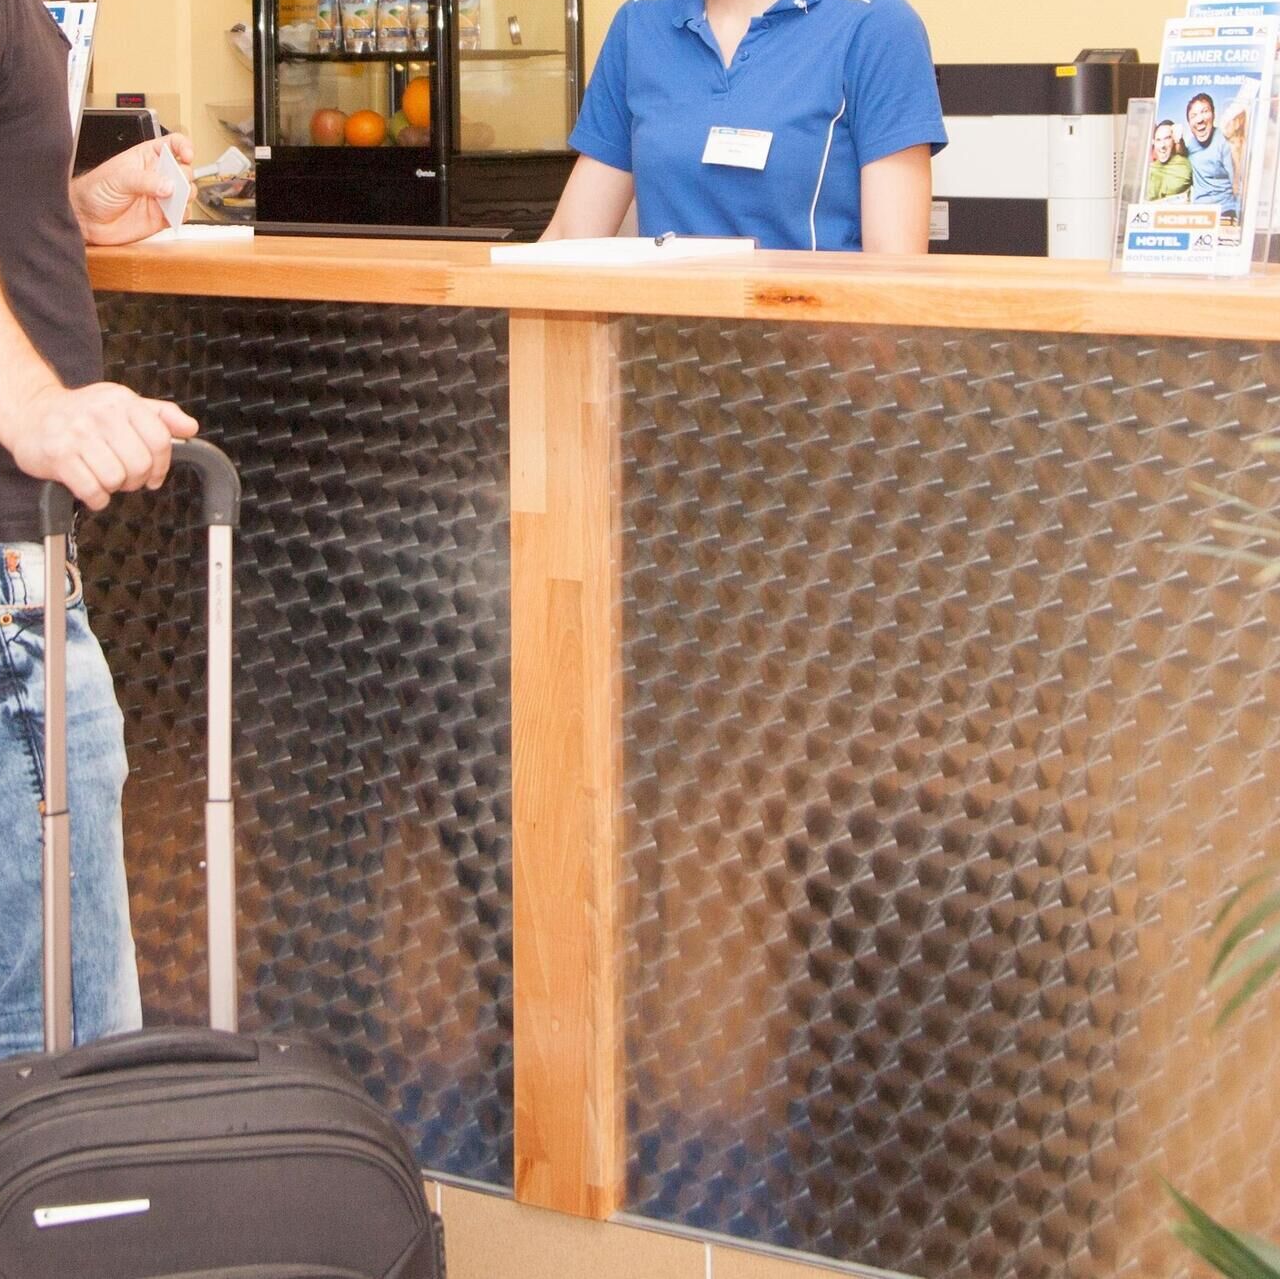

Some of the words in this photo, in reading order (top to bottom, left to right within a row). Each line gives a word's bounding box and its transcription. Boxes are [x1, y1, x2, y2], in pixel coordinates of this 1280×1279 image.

[1169, 50, 1222, 63] TRAINER
[1224, 49, 1260, 62] CARD
[1192, 74, 1211, 86] 10%
[1131, 211, 1150, 224] AO
[1156, 214, 1212, 225] HOSTEL
[1136, 236, 1182, 246] HOTEL
